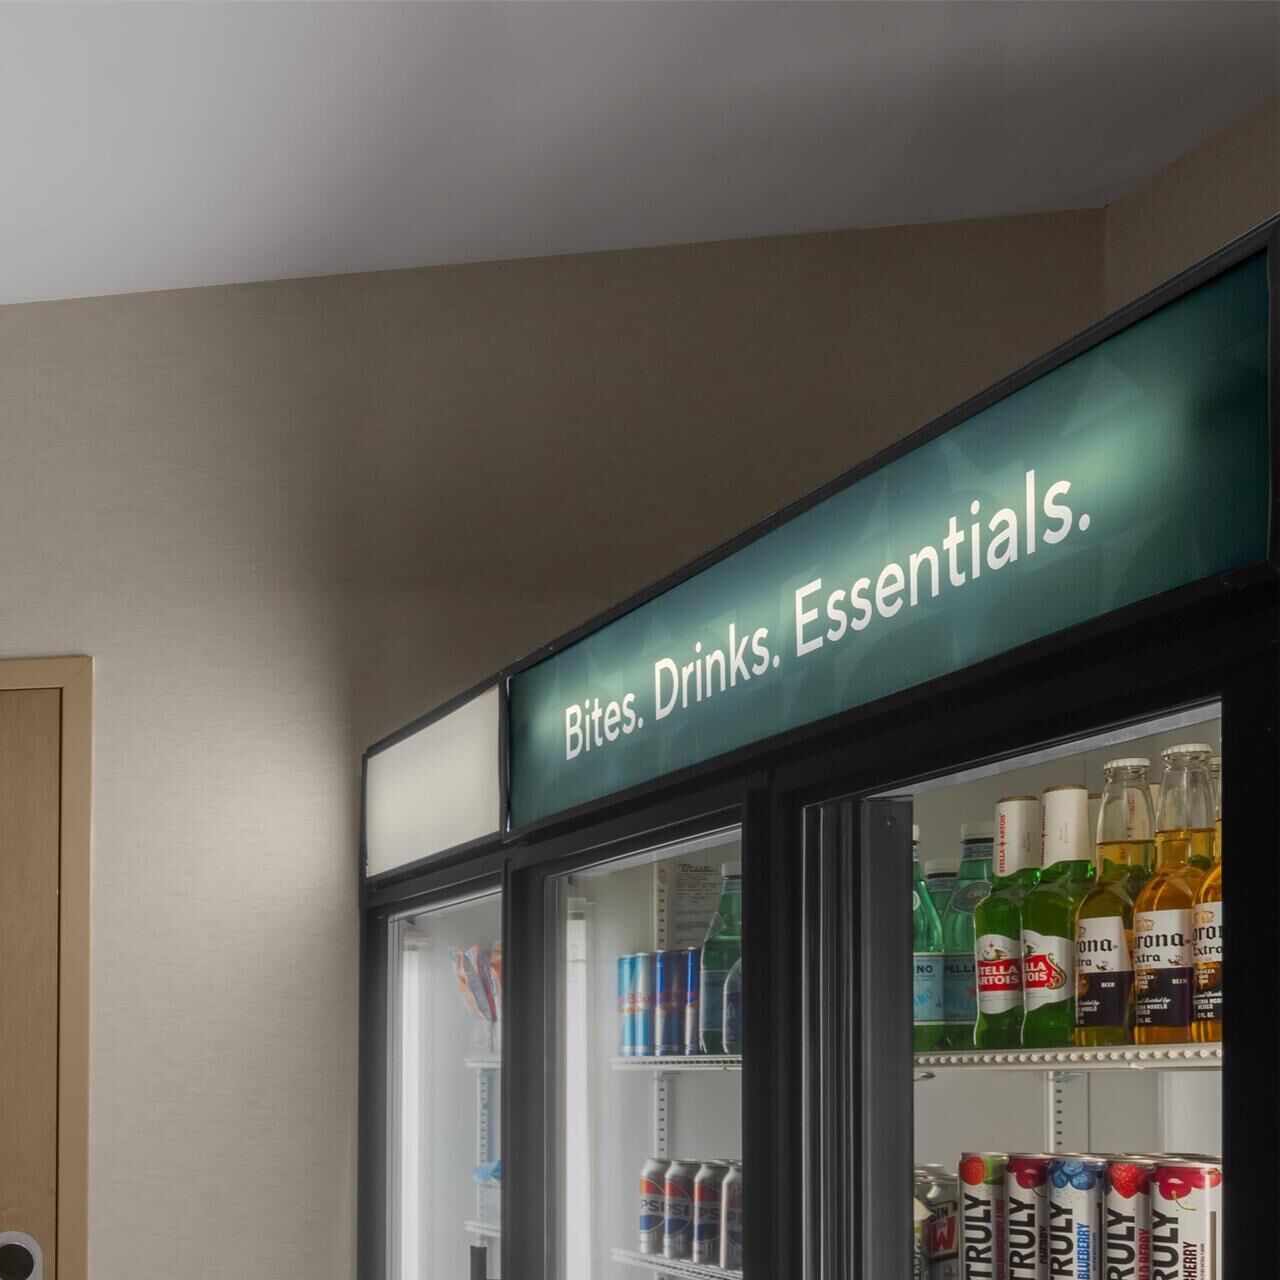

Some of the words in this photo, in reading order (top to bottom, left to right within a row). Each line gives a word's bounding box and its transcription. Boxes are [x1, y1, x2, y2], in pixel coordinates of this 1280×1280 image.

[566, 693, 644, 760] Bites.
[654, 623, 780, 720] Drinks.
[795, 470, 1090, 658] Essentials.
[978, 965, 1018, 977] TELLA
[1077, 1222, 1090, 1280] BLUEBERRY
[1139, 1228, 1151, 1262] BERRY
